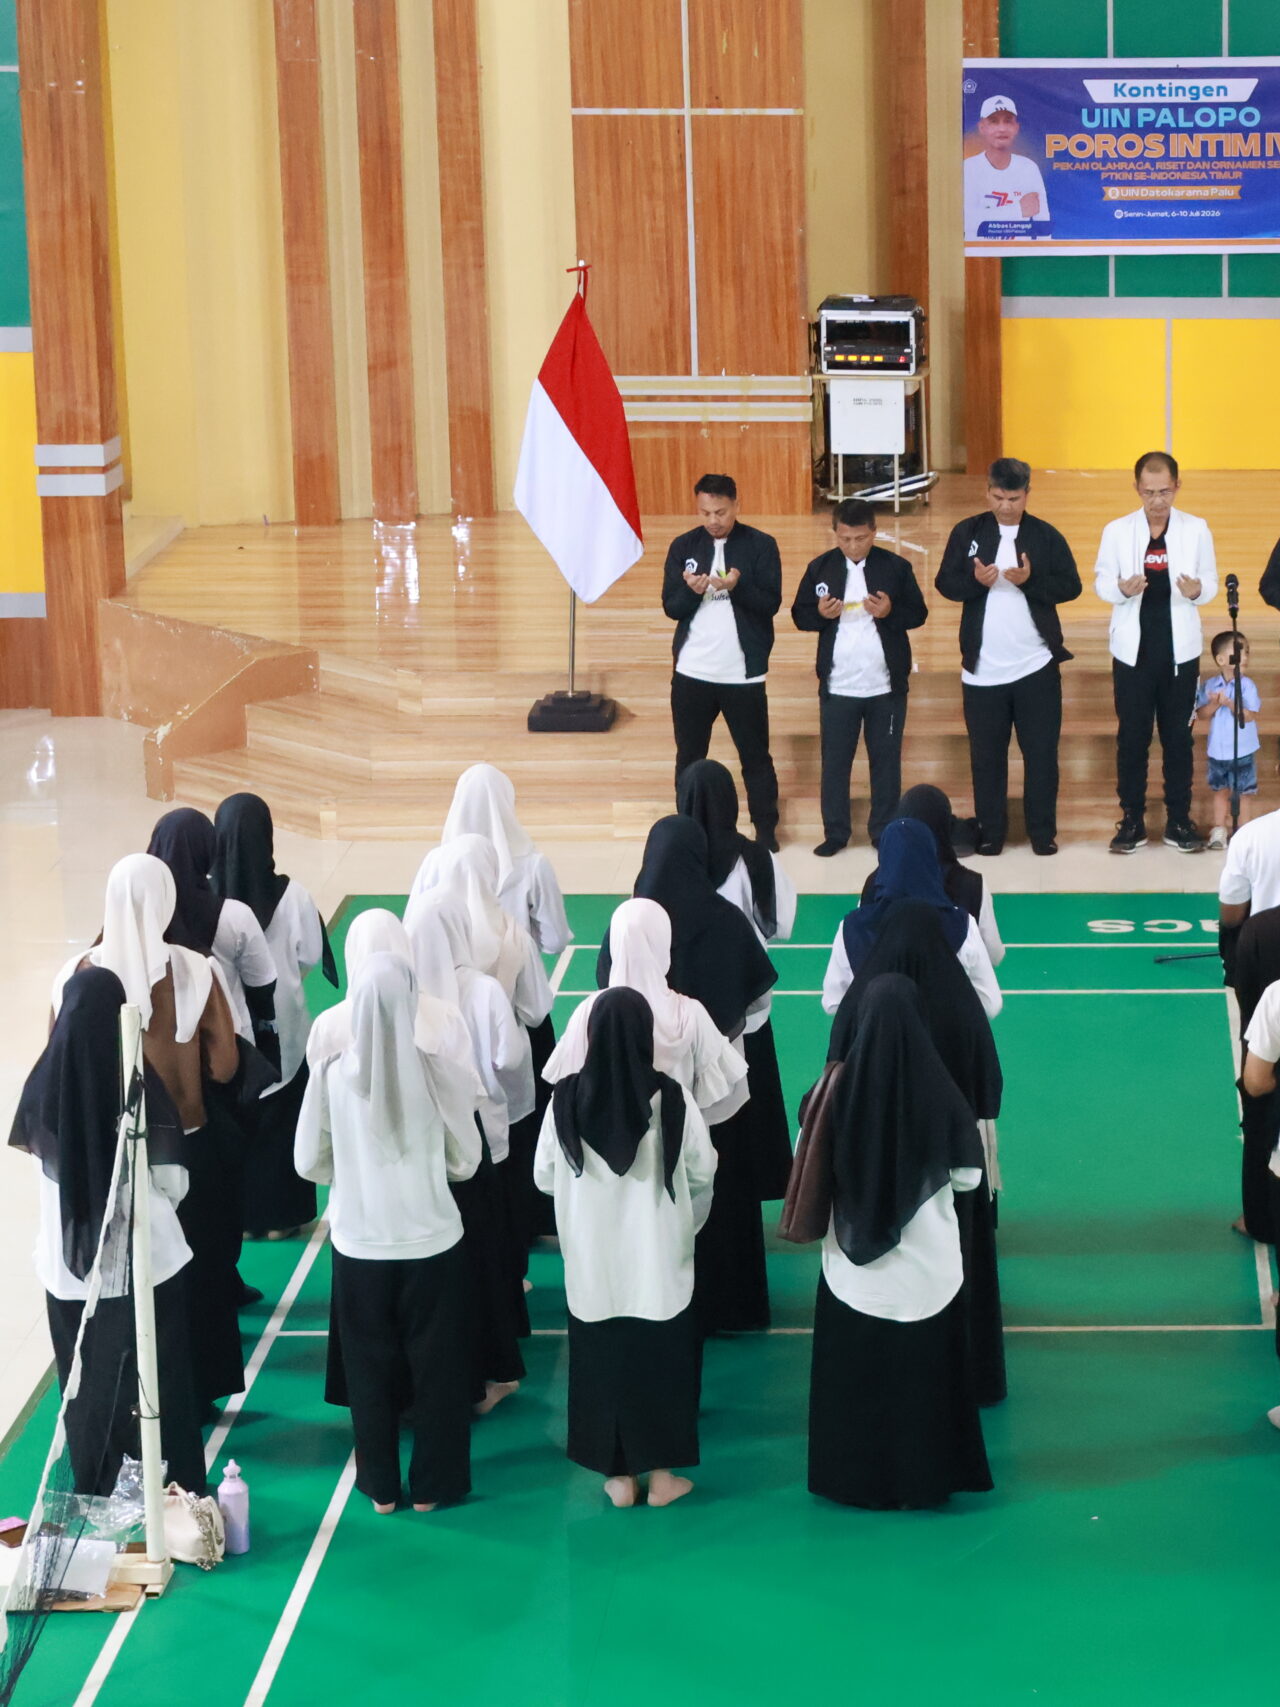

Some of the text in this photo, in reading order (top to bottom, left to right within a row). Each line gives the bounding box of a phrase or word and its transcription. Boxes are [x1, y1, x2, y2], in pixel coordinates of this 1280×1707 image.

[1113, 82, 1228, 101] Kontingen
[1081, 106, 1262, 129] UIN PALOPO
[1045, 133, 1166, 158] POROS
[1169, 132, 1261, 158] INTIM
[1053, 161, 1090, 171] PEKAN
[1091, 161, 1154, 171] OLAHRAGA,
[1155, 161, 1186, 170] RISET
[1187, 161, 1210, 170] DAN
[1211, 160, 1265, 170] ORNAMEN
[1101, 171, 1243, 180] PTKIN SE-INDONESIA TIMUR
[1120, 187, 1235, 197] UIN Datokarama Palu
[1144, 553, 1169, 564] evi
